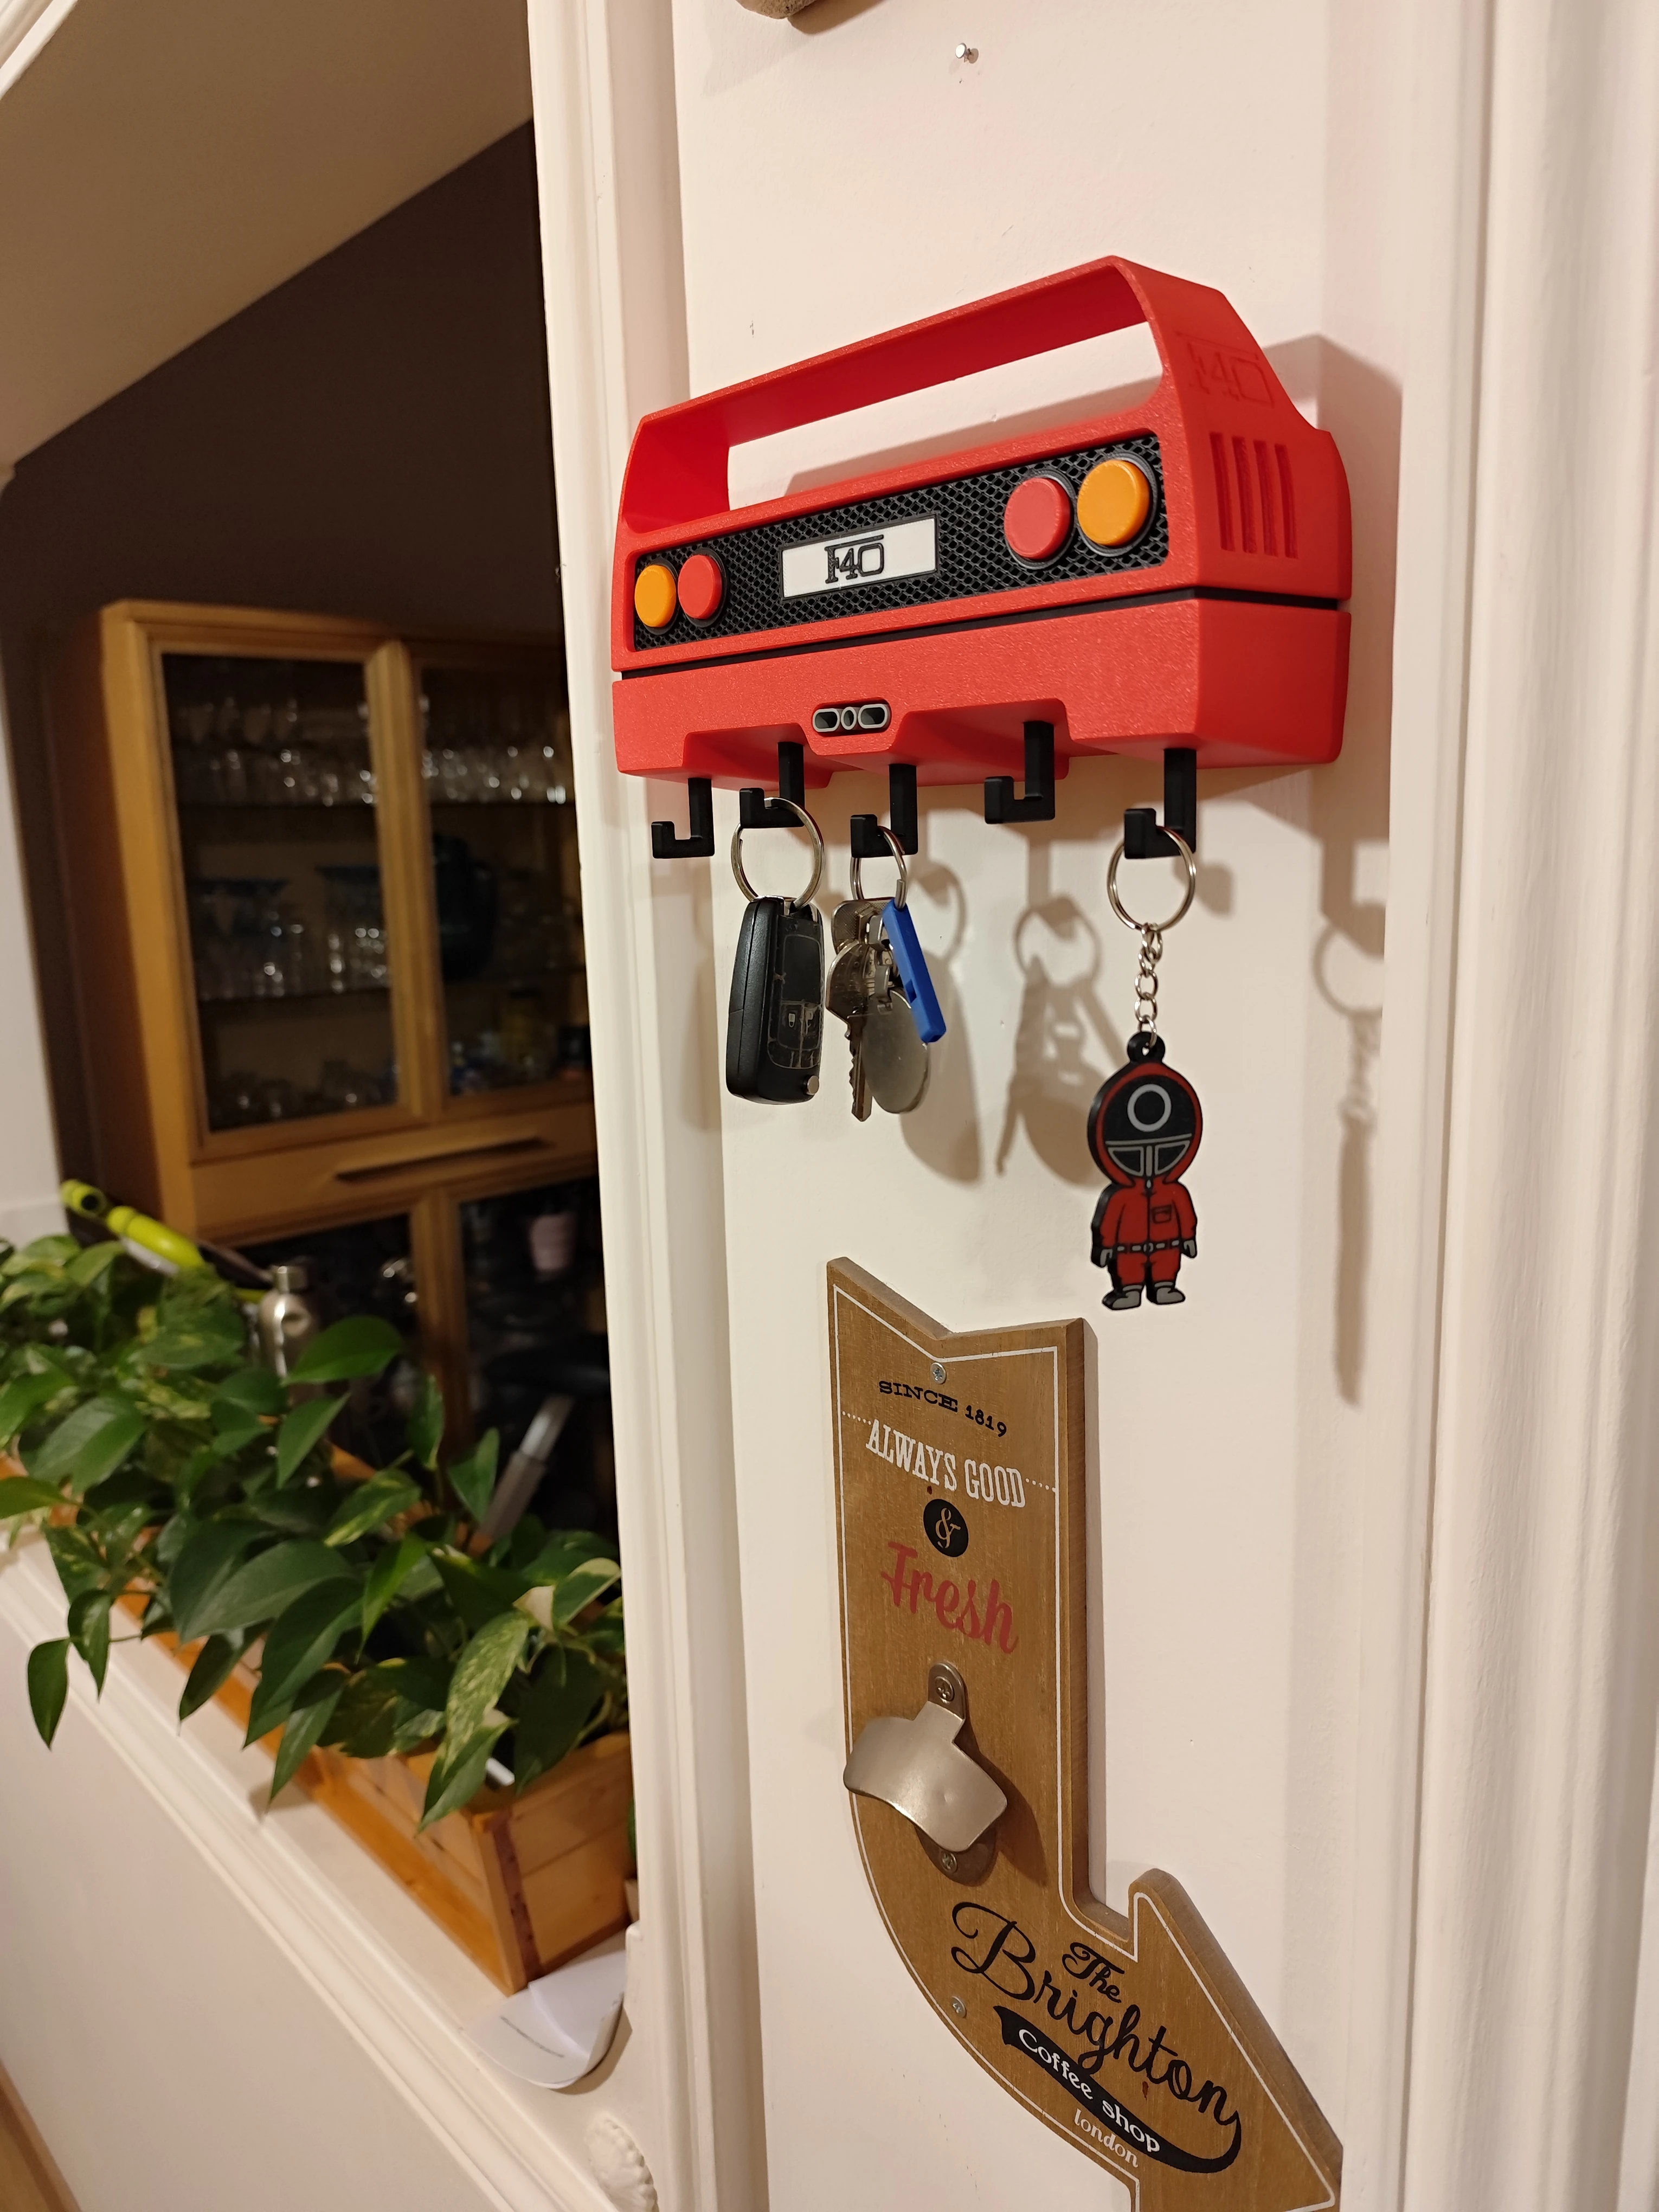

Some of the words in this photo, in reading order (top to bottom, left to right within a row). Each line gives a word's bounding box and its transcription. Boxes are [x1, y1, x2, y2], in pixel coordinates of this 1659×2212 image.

[824, 534, 884, 584] F40
[879, 1380, 958, 1412] SINCE
[965, 1405, 1007, 1438] 1819
[866, 1419, 957, 1491] ALWAYS
[964, 1458, 1026, 1508] GOOD
[935, 1507, 961, 1548] &
[881, 1541, 1019, 1654] Fresh
[1062, 1942, 1125, 2003] The
[950, 1901, 1239, 2126] Brighton
[1019, 2029, 1094, 2100] Coffee
[1102, 2104, 1160, 2153] shop
[1074, 2109, 1139, 2168] london
